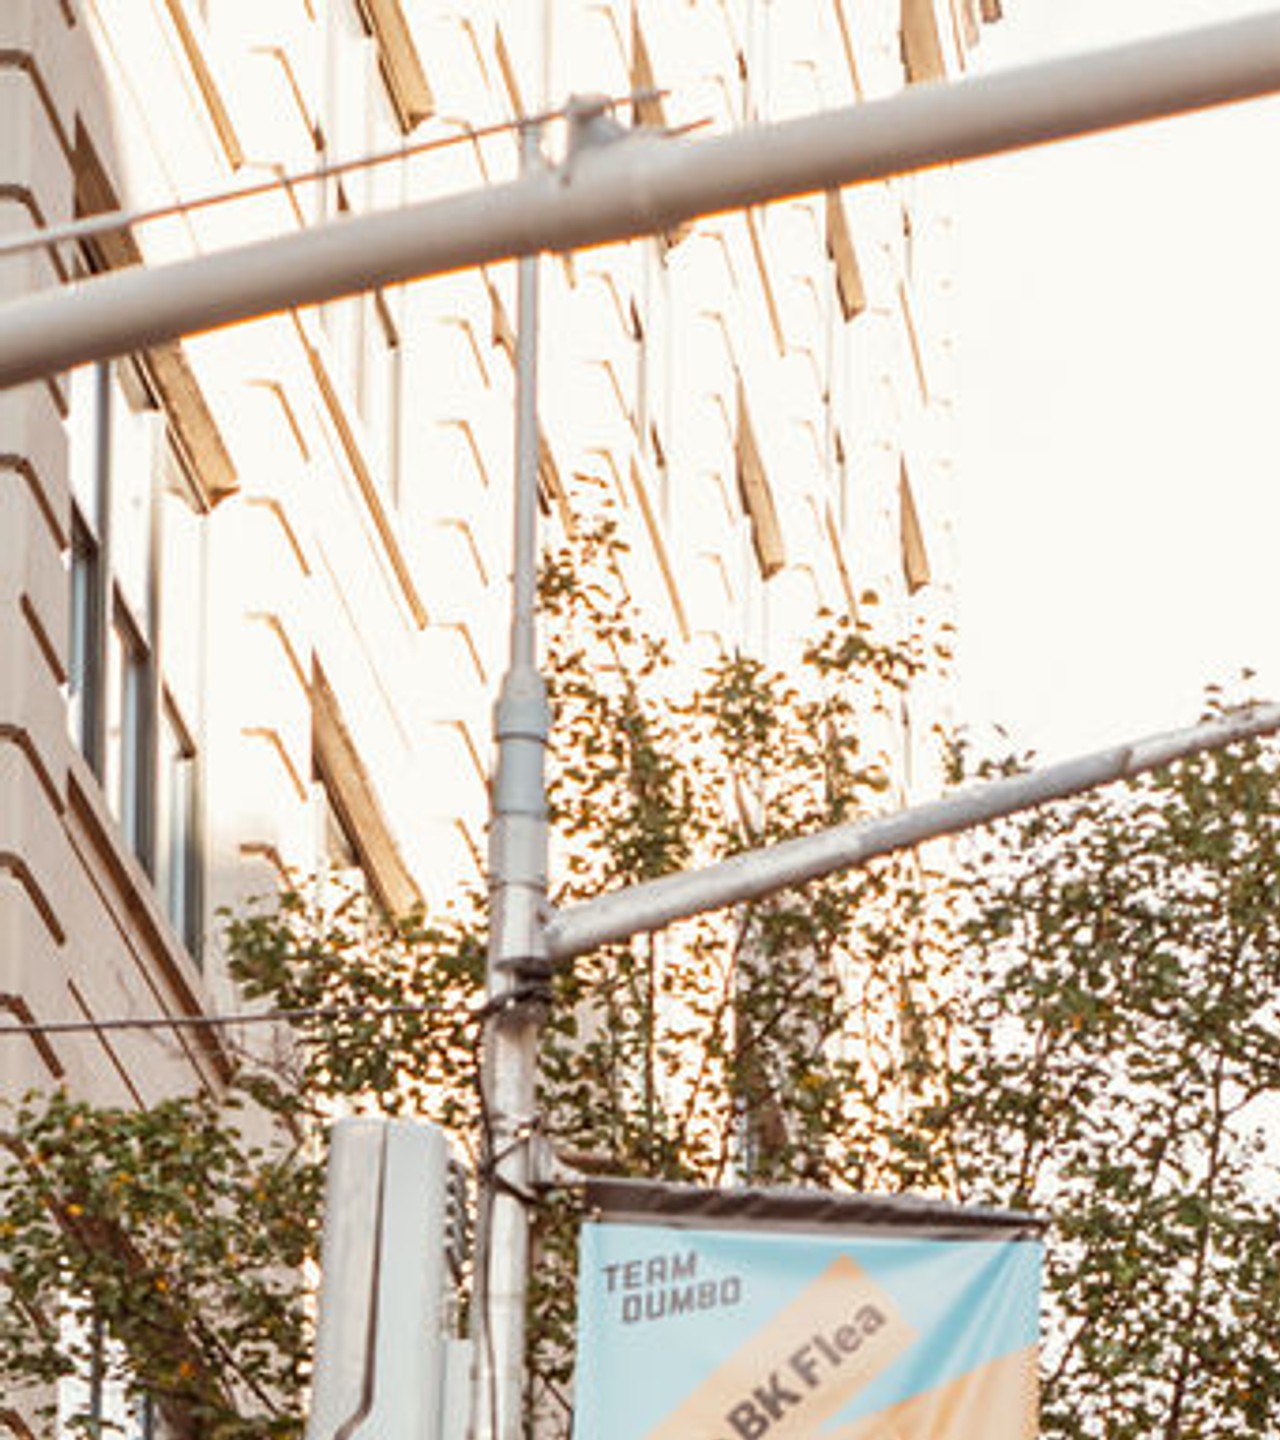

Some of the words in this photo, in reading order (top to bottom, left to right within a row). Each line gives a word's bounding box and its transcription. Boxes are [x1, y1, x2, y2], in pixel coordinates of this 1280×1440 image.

[604, 1250, 697, 1292] TEAM
[622, 1276, 741, 1323] DUMBO
[788, 1302, 887, 1389] Flea
